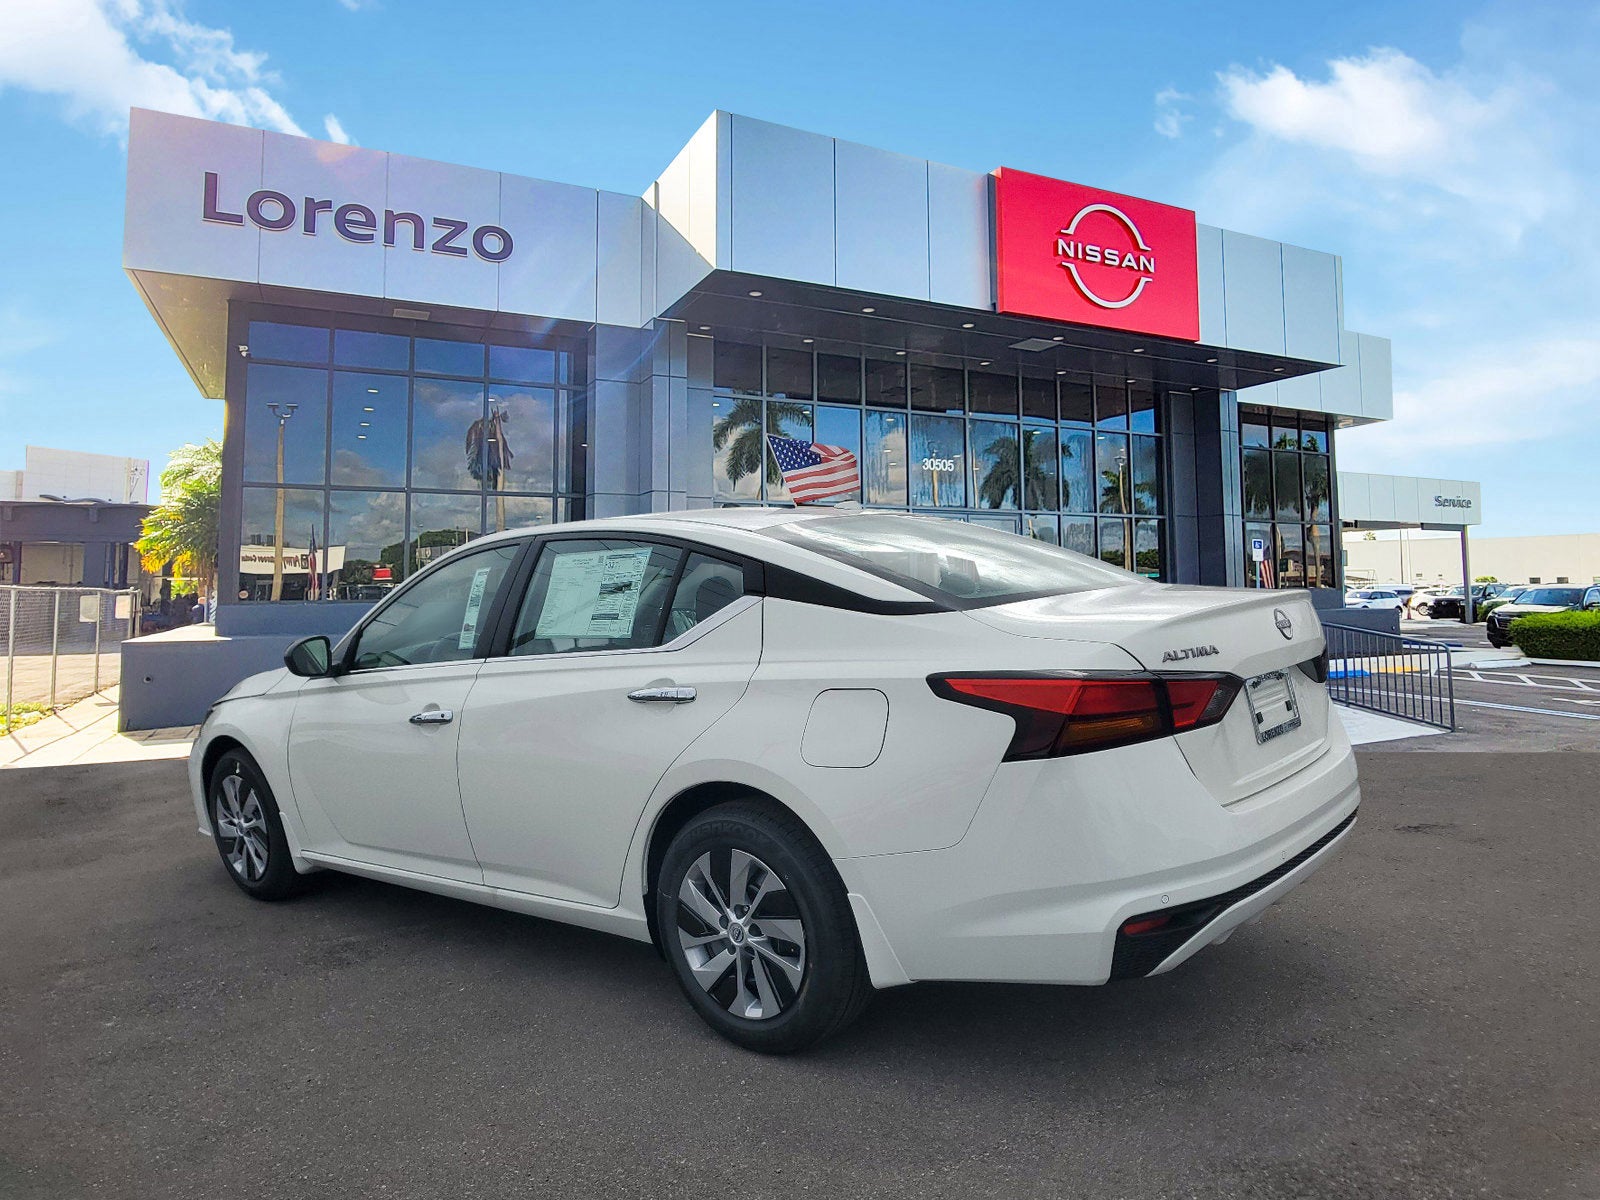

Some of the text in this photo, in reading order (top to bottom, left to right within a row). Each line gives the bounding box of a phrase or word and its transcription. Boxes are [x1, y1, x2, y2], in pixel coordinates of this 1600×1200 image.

[202, 171, 514, 262] Lorenzo
[1058, 238, 1155, 273] NISSAN
[922, 457, 955, 471] 30505
[1434, 495, 1472, 508] Service
[1162, 645, 1220, 662] ALTIMA
